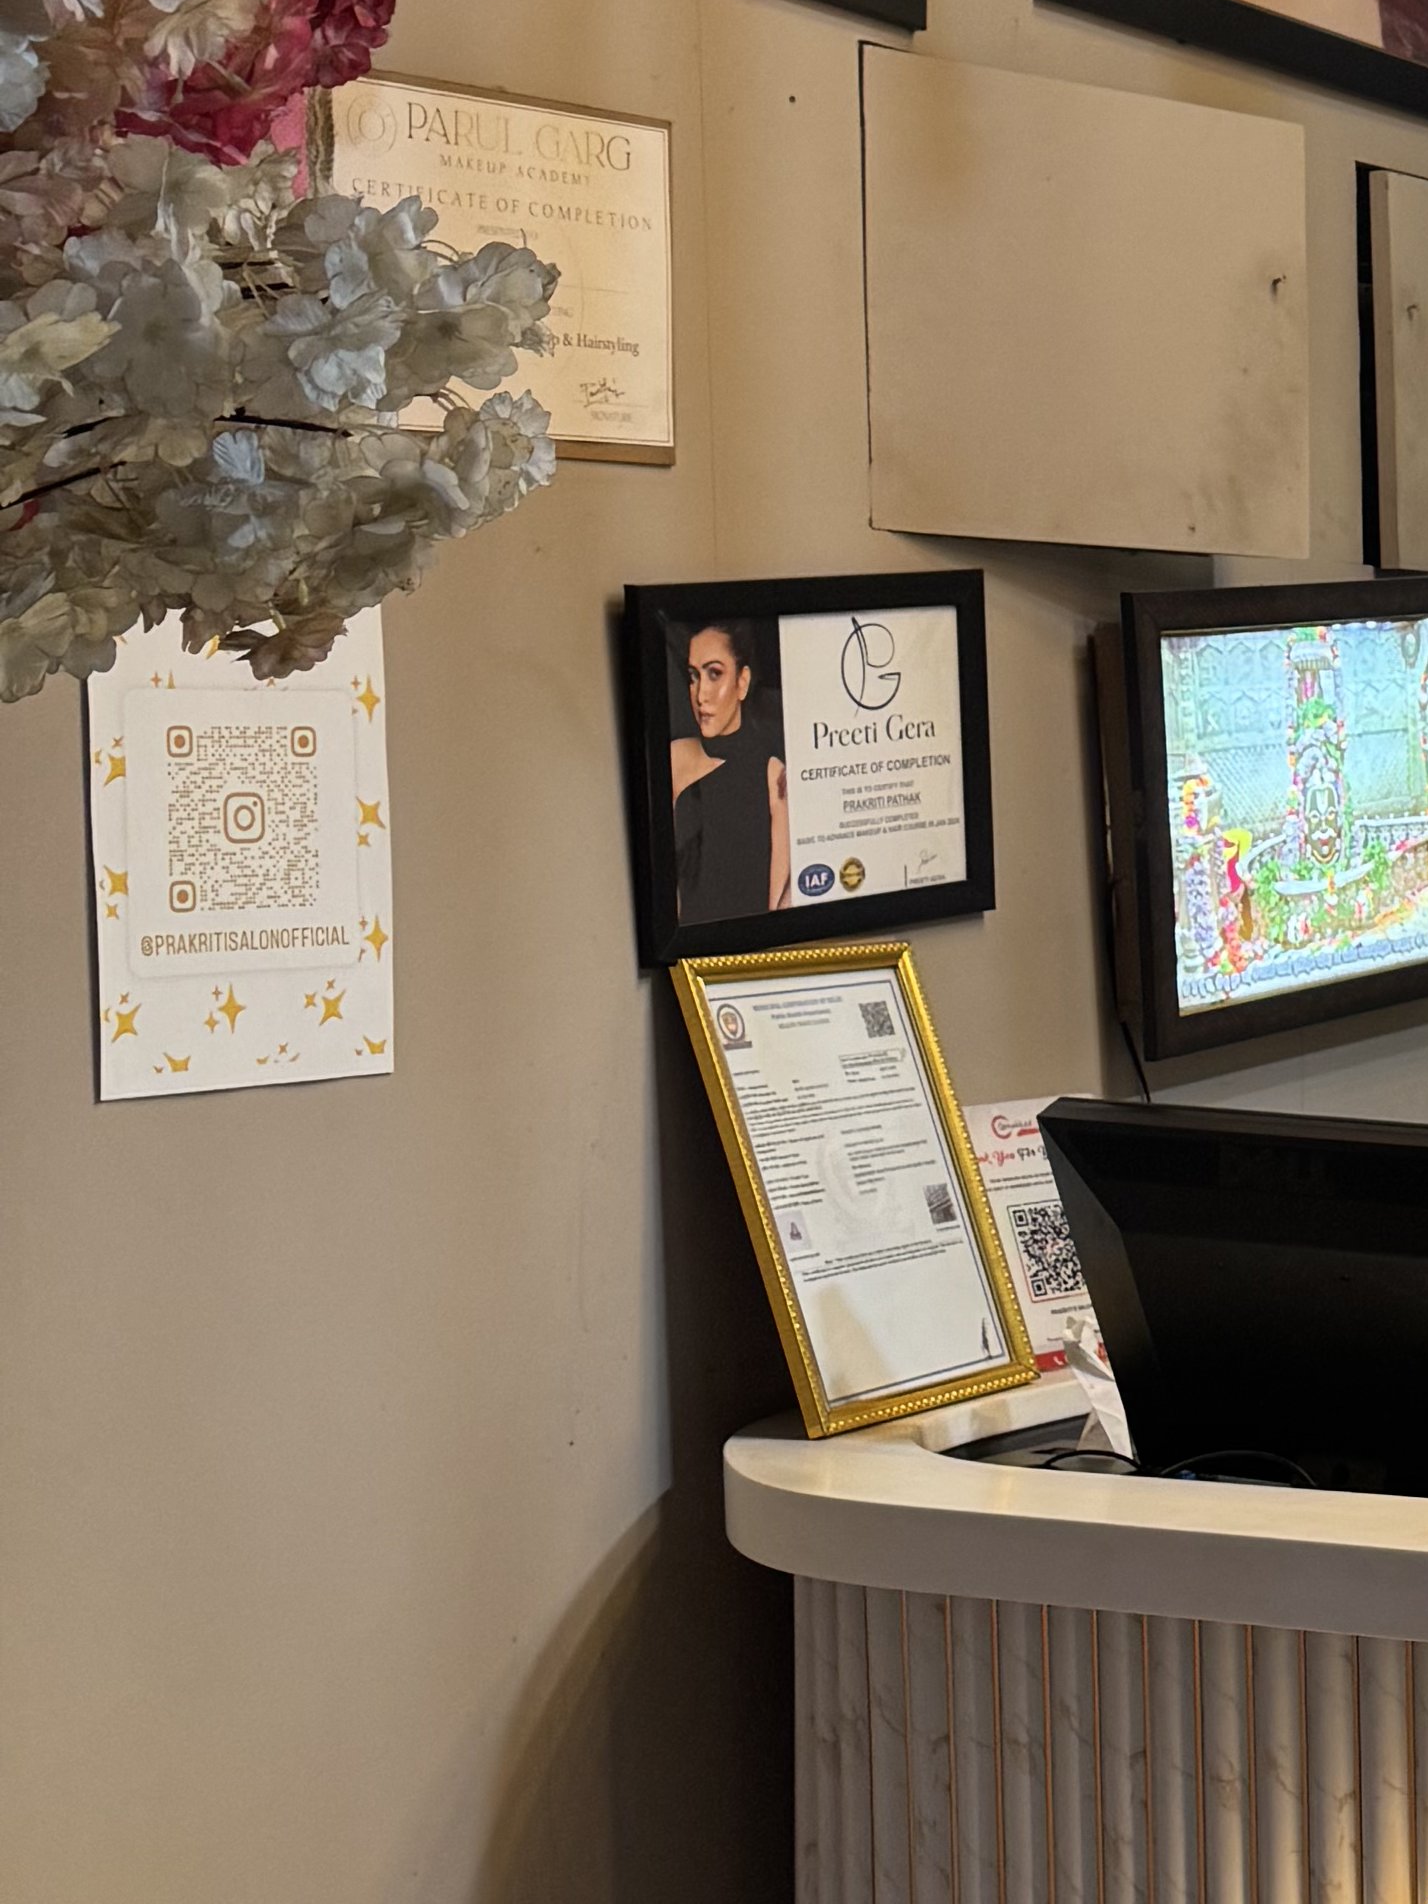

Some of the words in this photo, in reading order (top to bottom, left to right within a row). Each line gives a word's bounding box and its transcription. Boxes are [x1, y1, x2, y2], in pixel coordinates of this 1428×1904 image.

[406, 101, 522, 156] PARUL
[535, 123, 632, 171] GARG
[439, 154, 507, 175] MAKEUP
[516, 165, 590, 187] ACADEMY
[495, 197, 520, 214] OF
[528, 201, 653, 230] COMPLETION
[576, 332, 640, 357] Hairstyling
[812, 721, 878, 749] Preeti
[885, 714, 936, 742] Gera
[800, 762, 868, 781] CERTIFICATE
[870, 761, 884, 774] OF
[886, 754, 952, 772] COMPLETION
[843, 796, 885, 811] PRAKRITI
[886, 792, 921, 806] PATHAK
[804, 873, 829, 888] IAF
[141, 925, 350, 957] @PRAKRITISALONOFFICIAL
